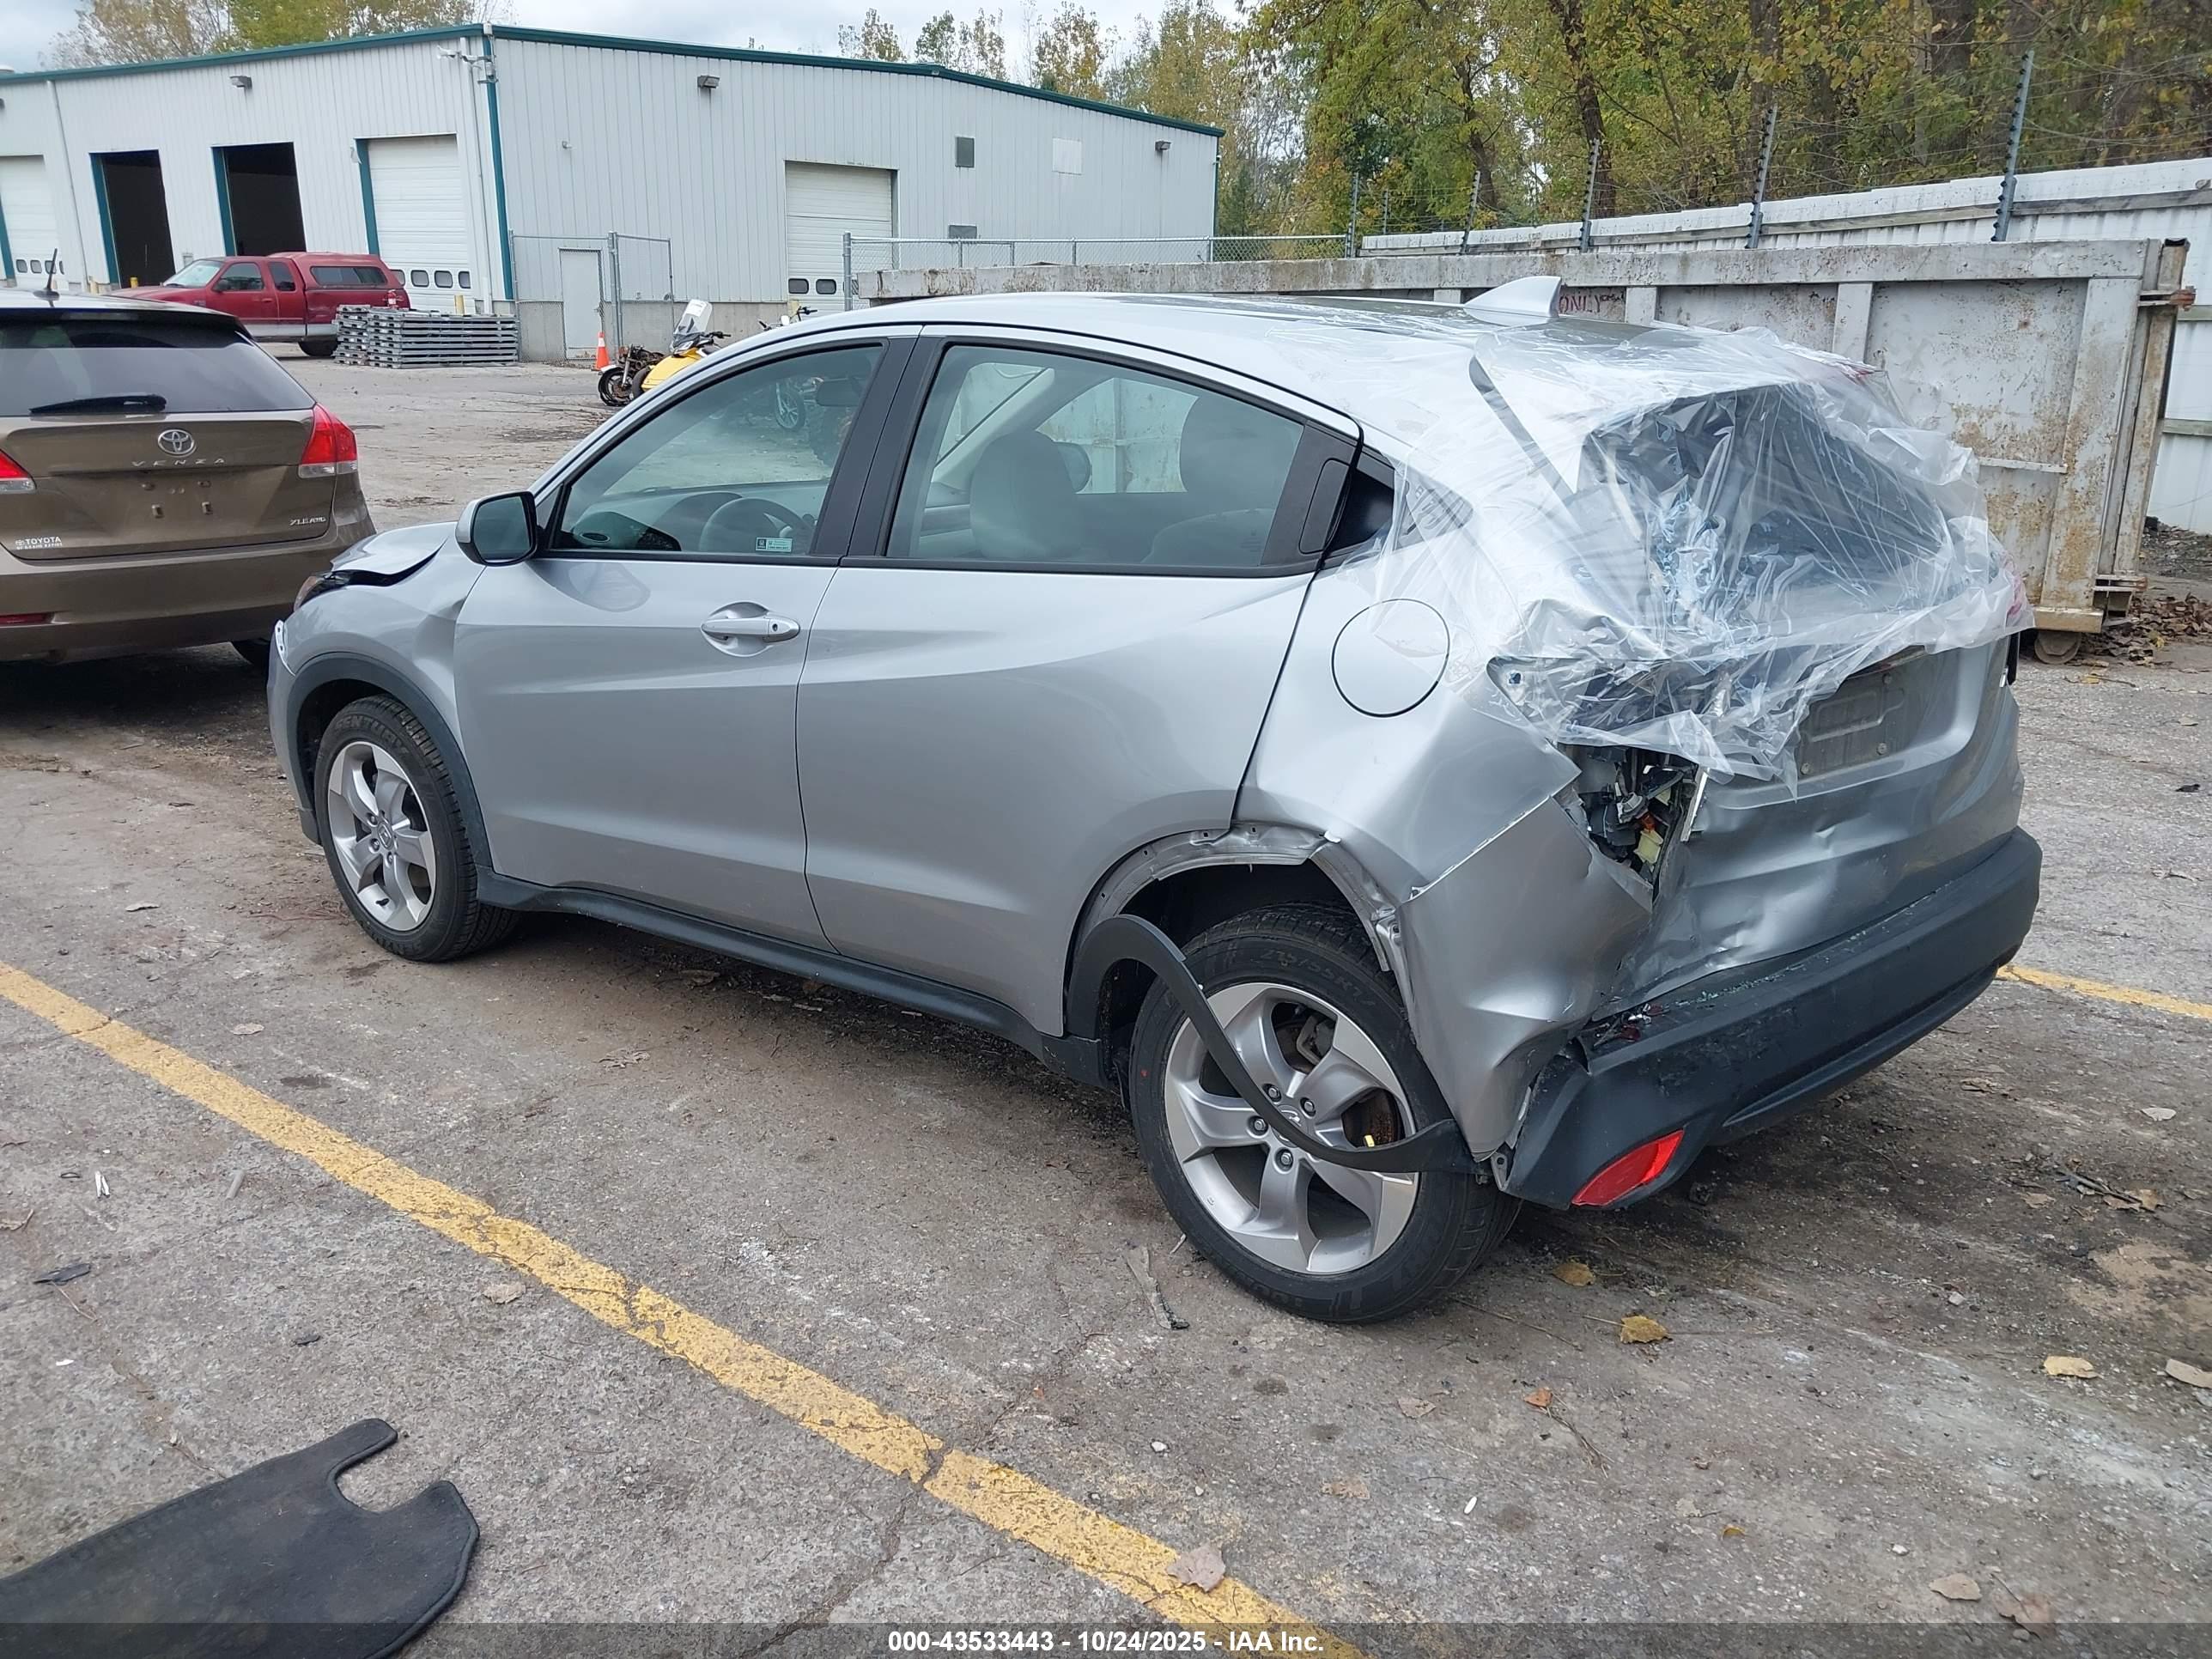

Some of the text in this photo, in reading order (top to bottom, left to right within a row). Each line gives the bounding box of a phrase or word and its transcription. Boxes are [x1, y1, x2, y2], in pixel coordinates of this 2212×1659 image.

[1559, 295, 1601, 314] ONLY
[131, 458, 225, 467] VENZA
[25, 536, 62, 545] TOYOTA
